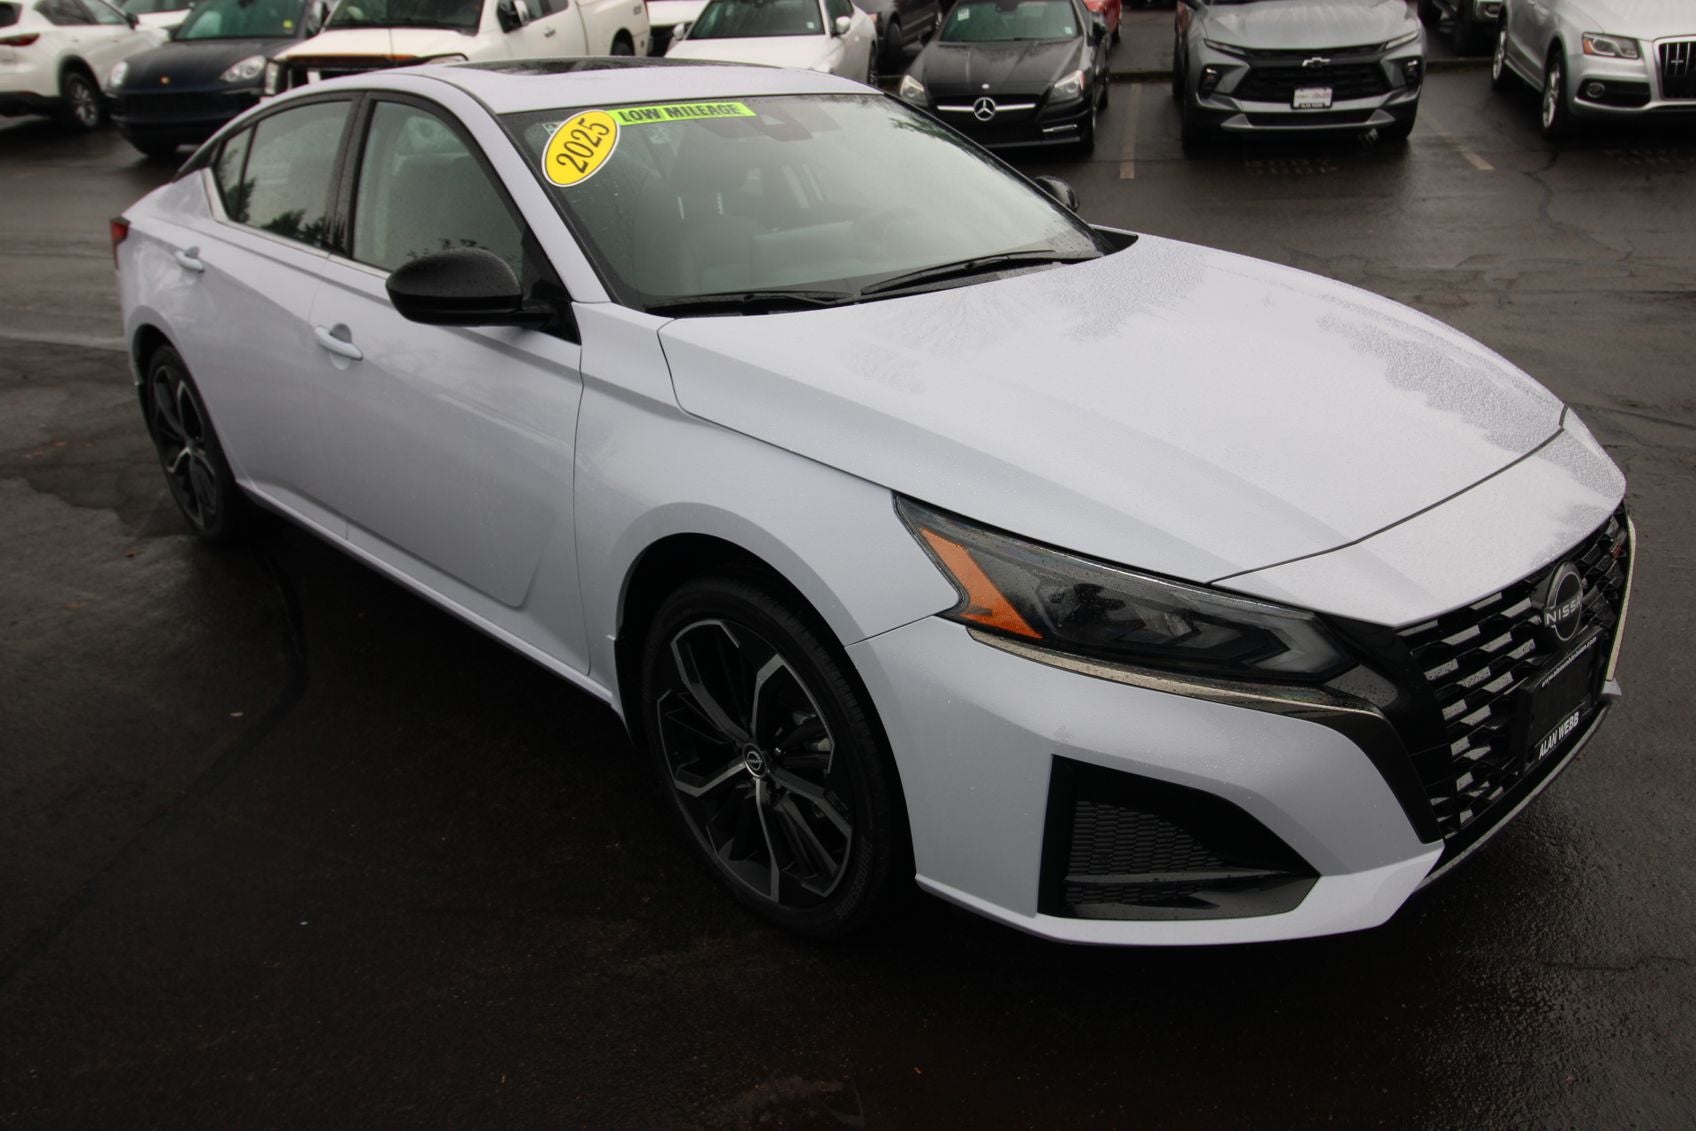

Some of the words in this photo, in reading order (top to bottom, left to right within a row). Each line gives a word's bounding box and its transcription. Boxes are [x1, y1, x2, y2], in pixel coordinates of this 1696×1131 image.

[619, 108, 661, 122] LOW
[664, 103, 740, 118] MILEAGE
[556, 118, 610, 174] 2025
[1538, 728, 1558, 761] ALAN
[1558, 711, 1579, 741] WEBB
